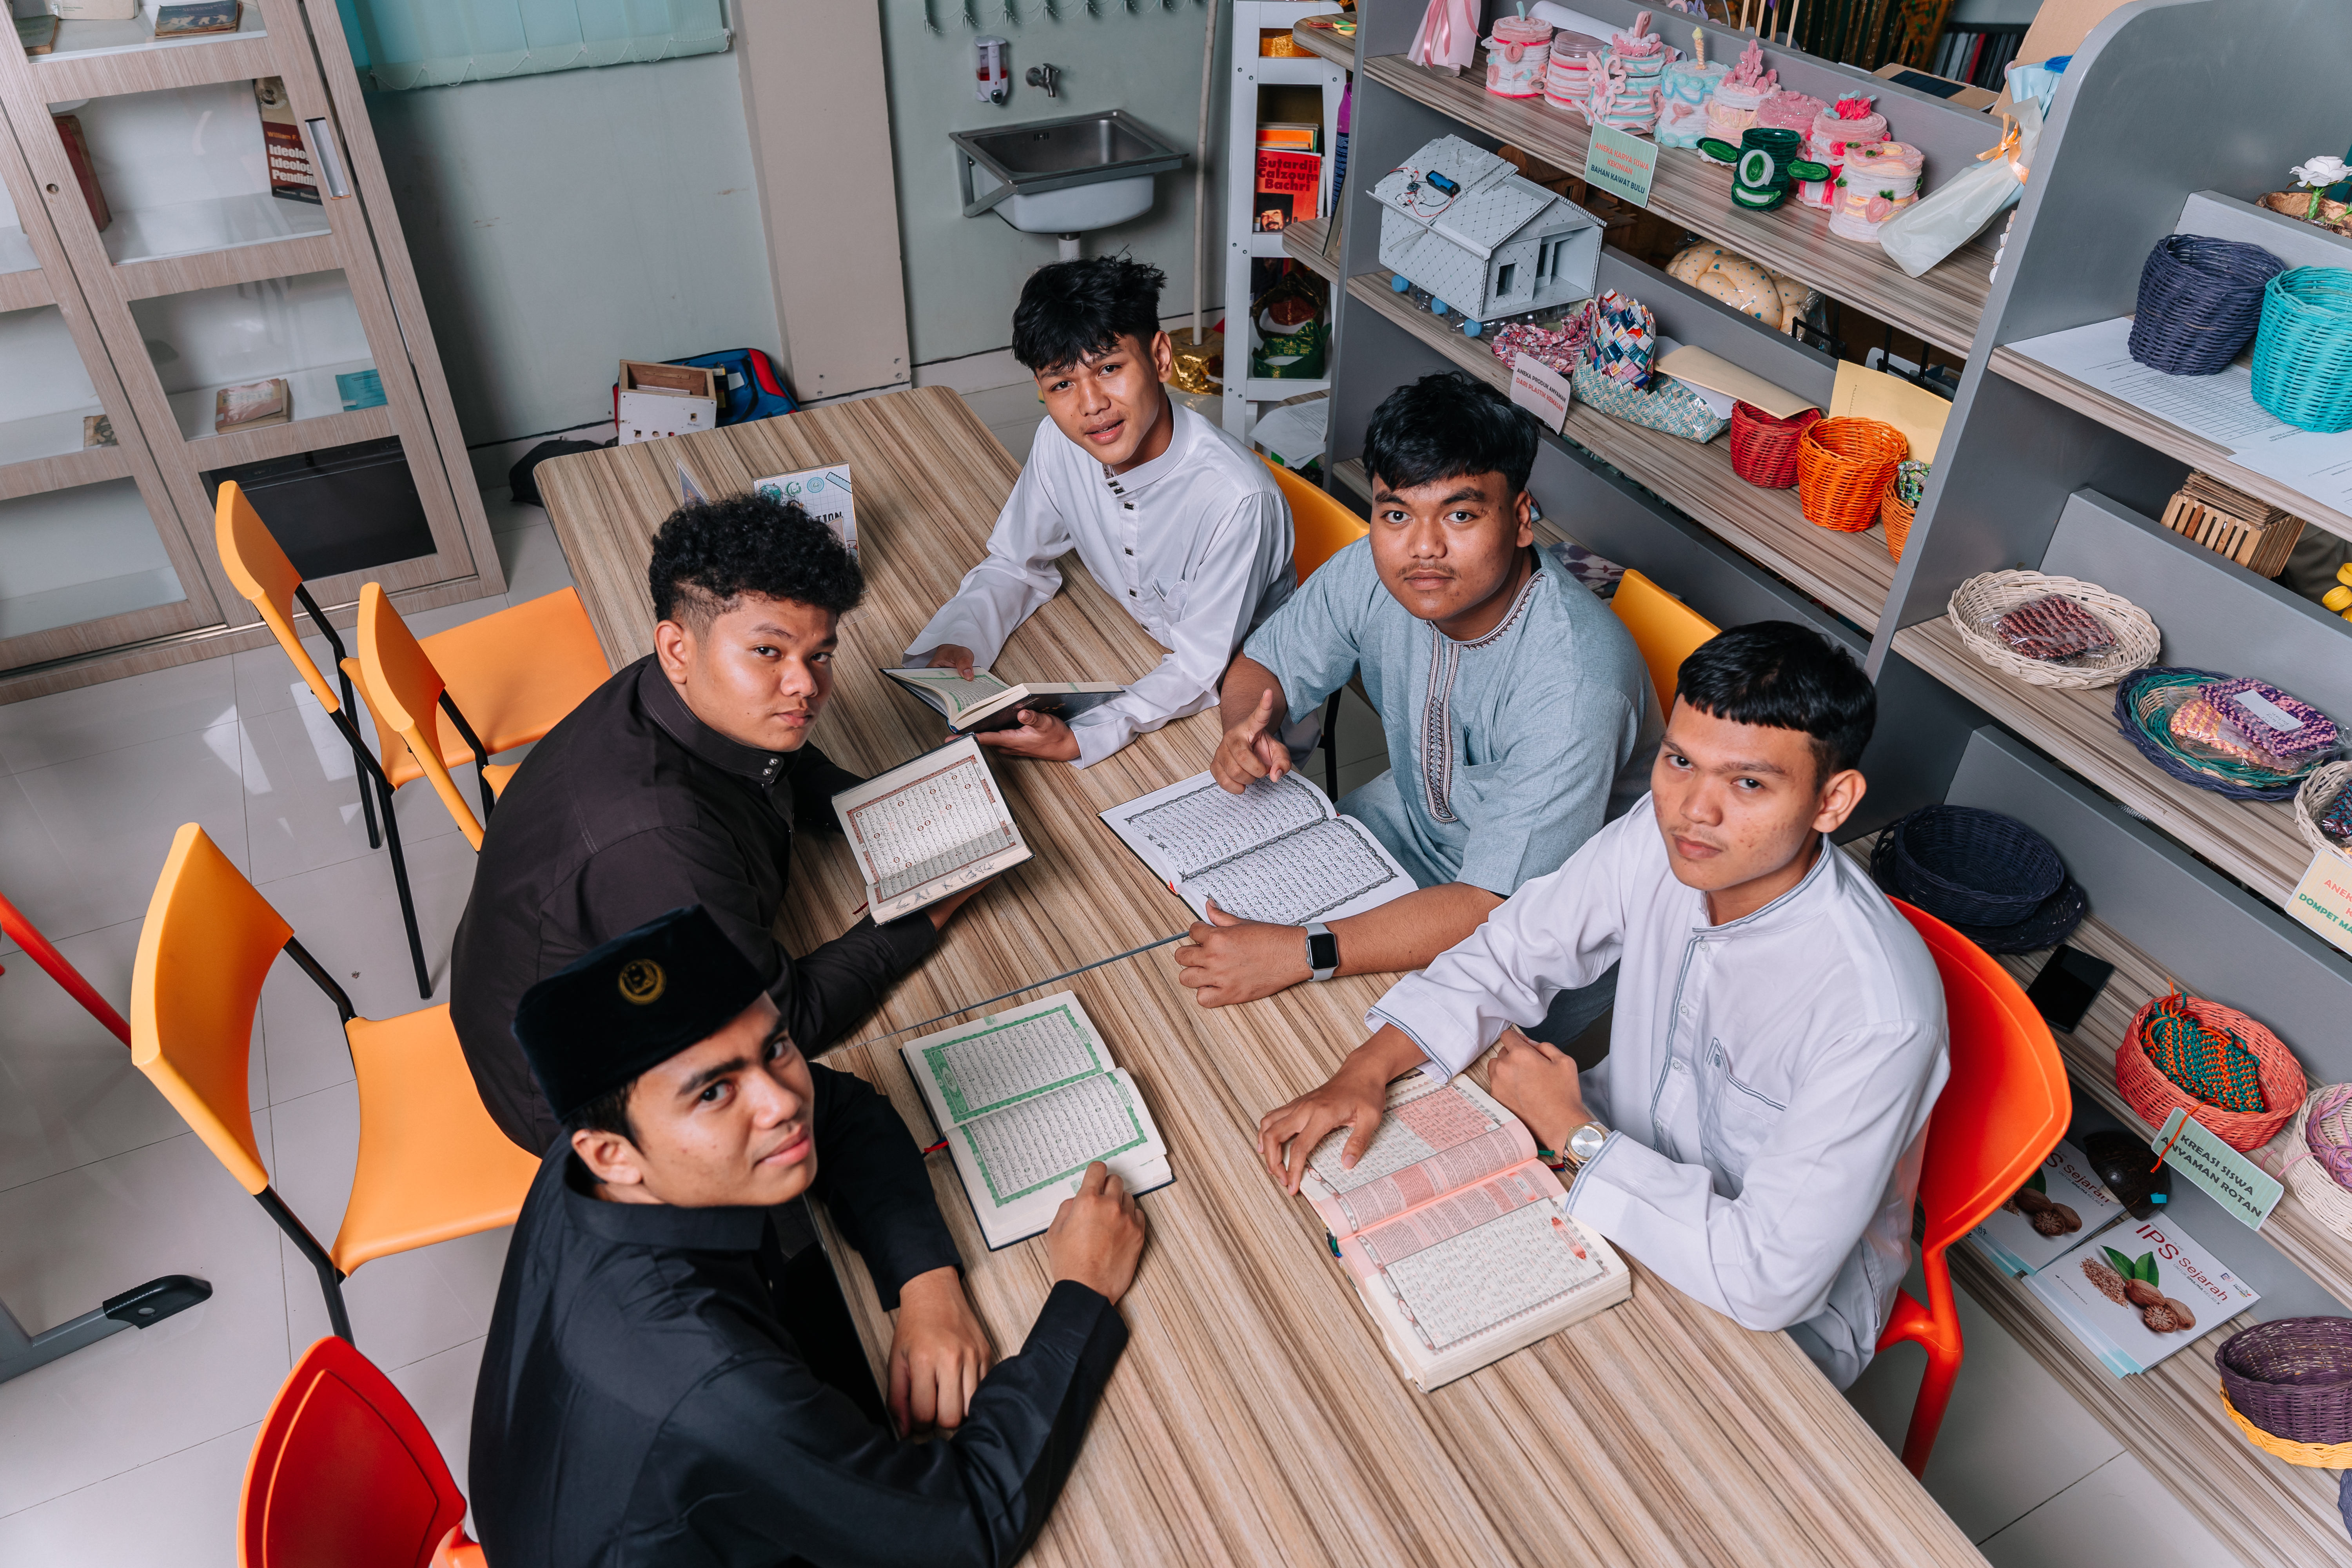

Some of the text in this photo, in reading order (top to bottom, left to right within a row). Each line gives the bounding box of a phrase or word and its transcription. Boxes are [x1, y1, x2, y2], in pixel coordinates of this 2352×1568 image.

[1258, 157, 1318, 173] Sutardji
[1595, 142, 1649, 171] ANEKA KARYA SISWA
[1607, 158, 1633, 175] KEKINIAN
[1257, 167, 1318, 181] Calzoum
[1265, 178, 1310, 191] Bachri
[1591, 164, 1645, 194] BAHAN KAWAT BULU
[1516, 377, 1563, 412] DARI PLASTIK KEMASAN
[1517, 368, 1566, 403] ANEKA PRODUK ANYAMAN
[809, 511, 842, 523] TION
[2299, 893, 2339, 922] DOMPET
[2161, 1136, 2262, 1217] ANYAMAN ROTAN
[2180, 1134, 2253, 1196] KREASI SISWA
[2058, 1171, 2072, 1182] UNTUK
[2071, 1181, 2087, 1195] SMA/MA
[2087, 1193, 2100, 1204] KELAS
[2135, 1224, 2227, 1301] IPS Sejarah
[2173, 1264, 2187, 1277] UNTUK
[2186, 1276, 2203, 1291] SMA/MA
[2203, 1290, 2217, 1303] KELAS
